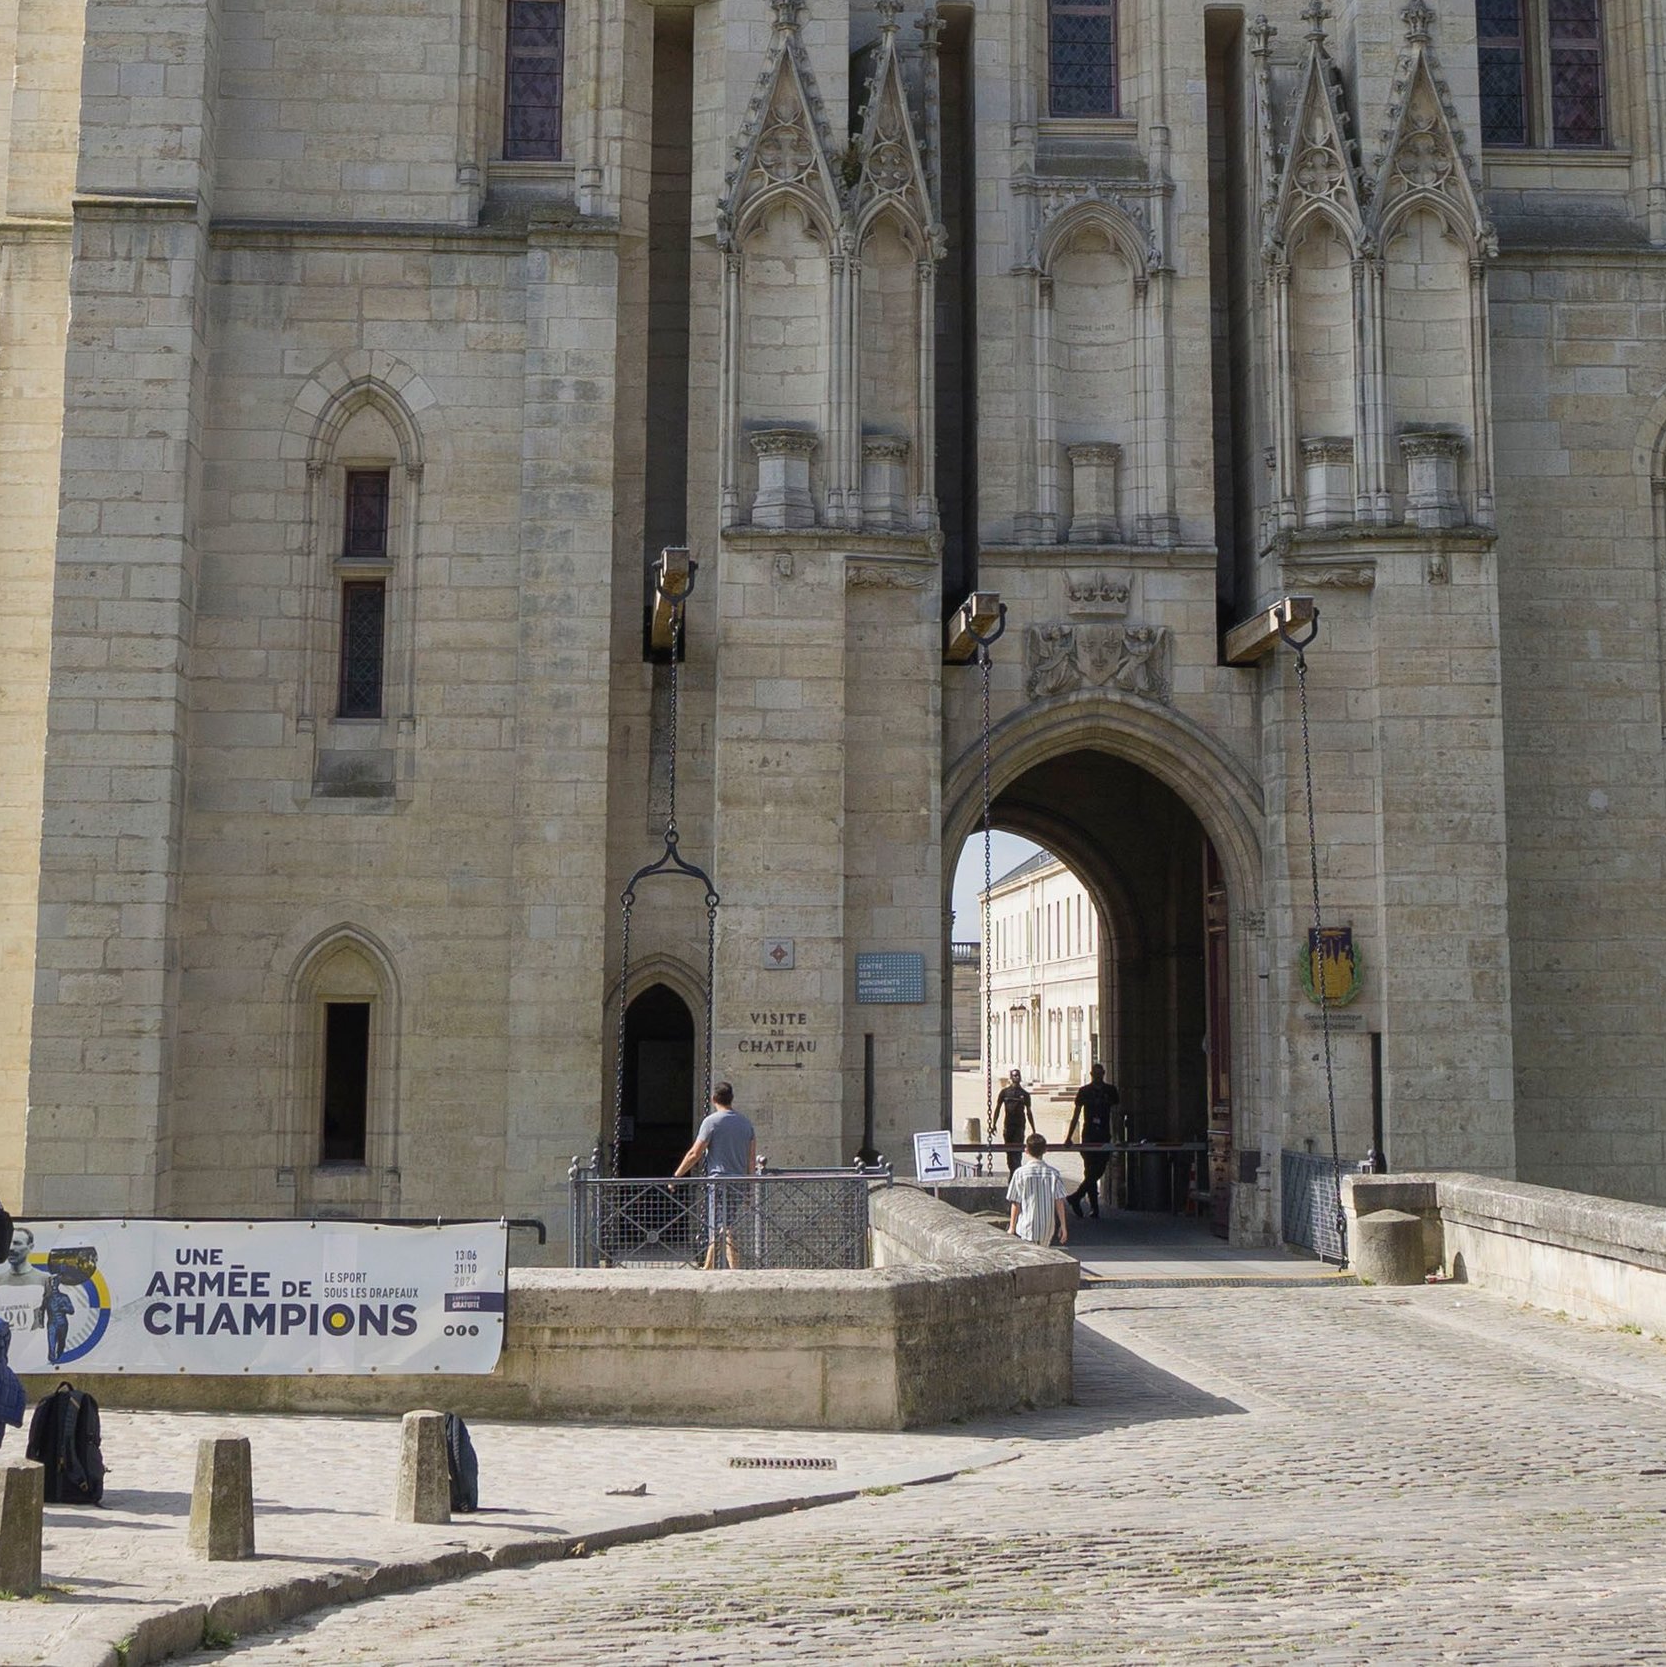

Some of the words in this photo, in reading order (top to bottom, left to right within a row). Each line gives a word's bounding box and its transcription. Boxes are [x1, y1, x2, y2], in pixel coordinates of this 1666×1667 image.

[750, 1013, 807, 1025] VISITE
[738, 1040, 818, 1053] CHATEAU
[175, 1248, 223, 1265] UNE
[324, 1272, 334, 1283] LE
[337, 1272, 367, 1283] SPORT
[282, 1281, 312, 1297] DE
[324, 1287, 348, 1299] SOUS
[351, 1287, 366, 1299] LES
[369, 1287, 419, 1299] DRAPEAUX
[143, 1302, 418, 1336] CHAMPIONS
